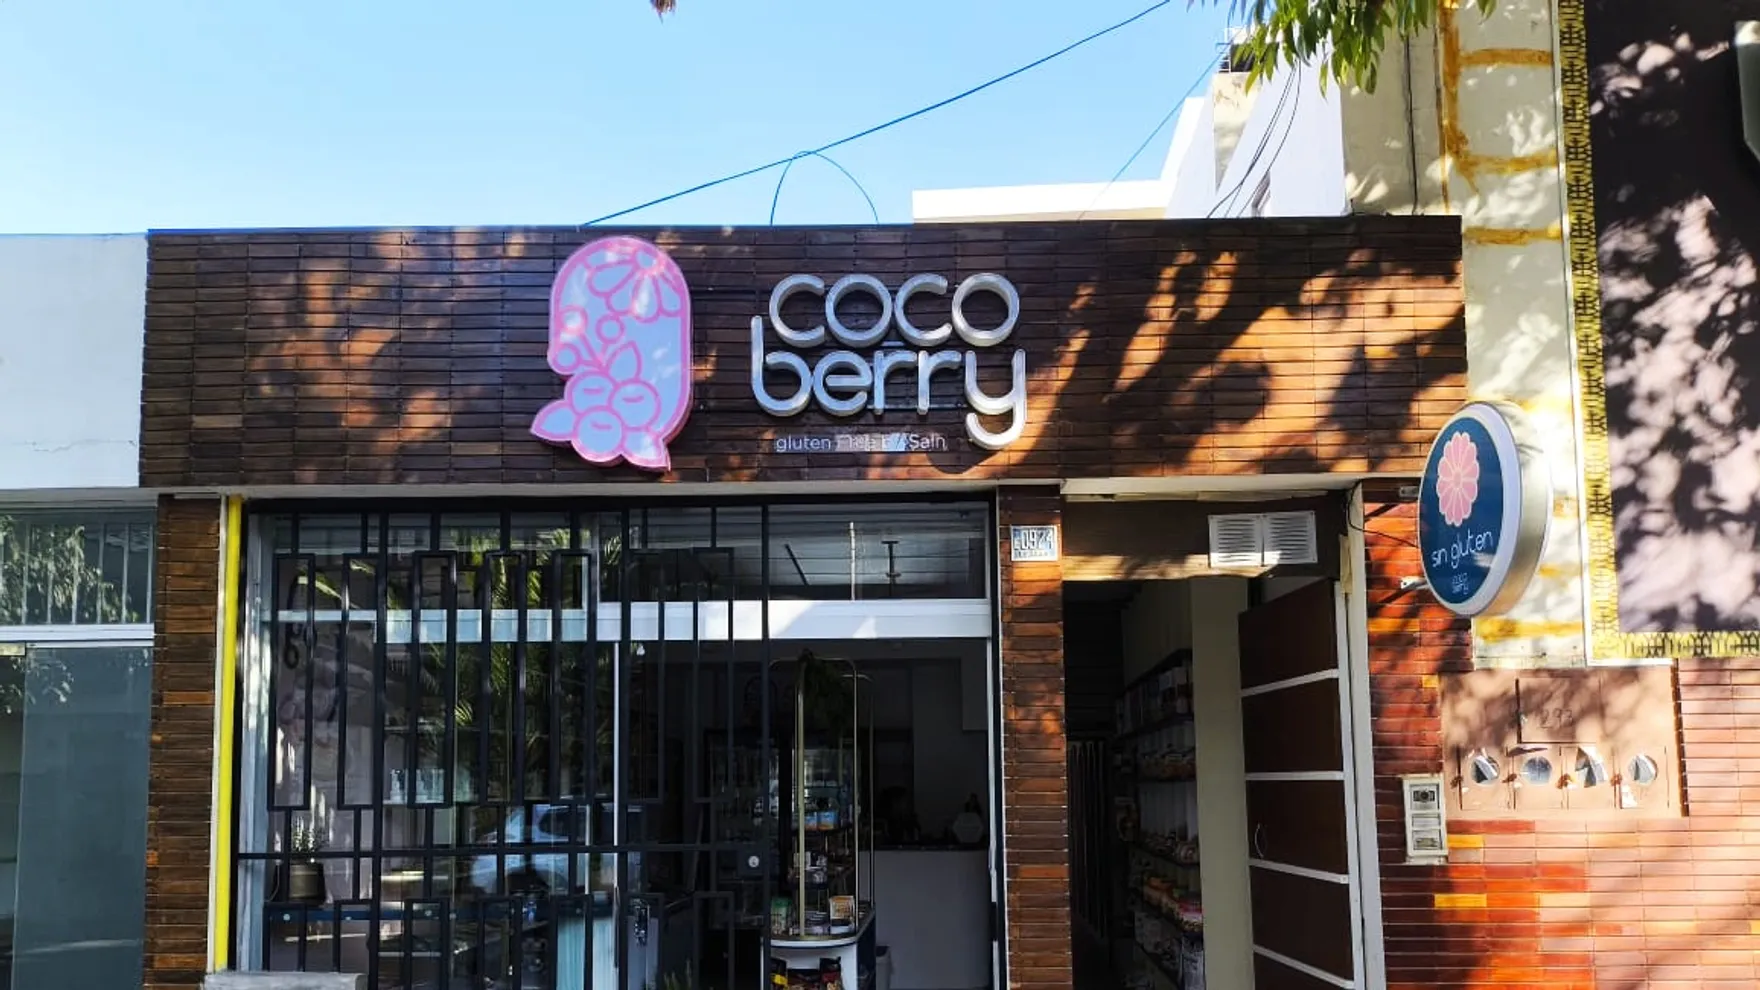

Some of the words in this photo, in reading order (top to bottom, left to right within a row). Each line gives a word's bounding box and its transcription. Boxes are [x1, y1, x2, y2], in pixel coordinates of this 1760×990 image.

[769, 272, 1020, 347] coco
[750, 315, 1028, 450] berry
[776, 435, 832, 452] gluten
[1431, 548, 1448, 568] sin
[1450, 528, 1493, 570] gluten
